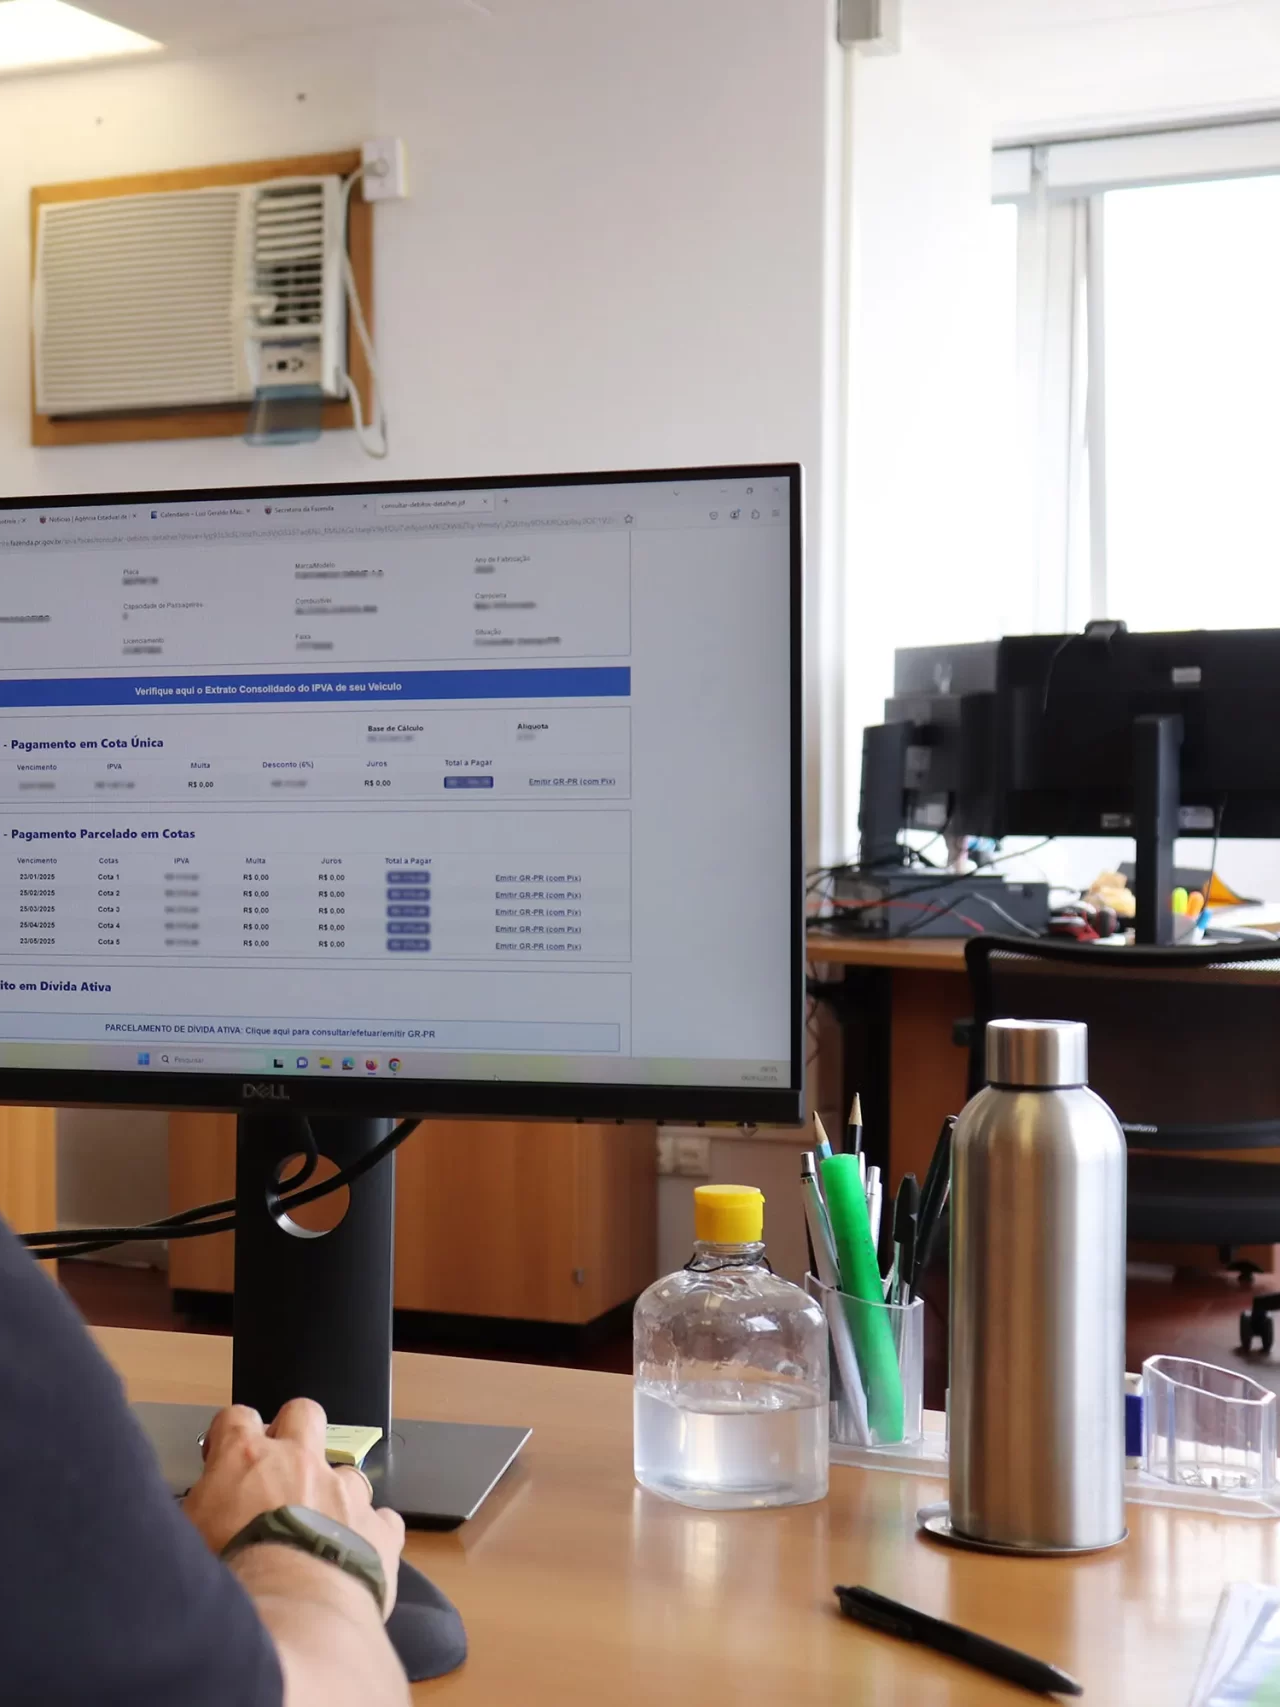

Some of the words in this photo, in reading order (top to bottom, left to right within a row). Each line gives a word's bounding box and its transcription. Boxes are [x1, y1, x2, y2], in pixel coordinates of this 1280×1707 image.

[134, 686, 173, 697] Verifique
[174, 686, 195, 696] aqui
[205, 685, 237, 694] Extrato
[239, 683, 296, 694] Consolidado
[298, 683, 310, 693] do
[311, 683, 333, 692] IPVA
[335, 682, 347, 692] de
[349, 683, 366, 692] seu
[386, 724, 396, 732] de
[397, 723, 424, 732] Cálculo
[11, 738, 76, 753] Pagamento
[79, 740, 98, 750] em
[101, 738, 128, 749] Cota
[131, 735, 164, 749] Única
[16, 763, 58, 771] Vencimento
[262, 761, 297, 769] Desconto
[365, 760, 388, 768] Juros
[444, 759, 462, 767] Total
[470, 759, 493, 768] Pagar
[187, 781, 197, 789] R$
[198, 781, 214, 789] 0,00
[364, 780, 374, 788] R$
[11, 829, 76, 842] Pagamento
[80, 828, 138, 840] Parcelado
[140, 831, 159, 840] em
[162, 828, 196, 840] Cotas
[16, 857, 58, 865] Vencimento
[98, 857, 119, 865] Cotas
[245, 857, 266, 865] Multa
[320, 857, 342, 865] Juros
[385, 857, 403, 865] Total
[410, 857, 432, 866] Pagar
[97, 873, 114, 881] Cota
[243, 874, 253, 882] R$
[254, 874, 270, 882] 0,00
[318, 874, 328, 882] R$
[329, 874, 346, 882] 0,00
[97, 890, 114, 898] Cota
[243, 890, 253, 898] R$
[254, 890, 270, 898] 0,00
[318, 891, 328, 899] R$
[329, 891, 346, 899] 0,00
[97, 906, 114, 914] Cota
[243, 907, 253, 915] R$
[254, 907, 270, 915] 0,00
[318, 907, 328, 915] R$
[329, 907, 346, 915] 0,00
[97, 922, 114, 930] Cota
[243, 923, 253, 931] R$
[254, 923, 270, 931] 0,00
[318, 924, 328, 932] R$
[329, 924, 346, 932] 0,00
[97, 938, 114, 946] Cota
[243, 939, 253, 947] R$
[254, 939, 270, 947] 0,00
[318, 941, 328, 949] R$
[329, 941, 346, 949] 0,00
[19, 983, 37, 991] em
[40, 979, 77, 992] Dívida
[81, 980, 112, 993] Ativa
[105, 1023, 172, 1033] PARCELAMENTO
[174, 1025, 185, 1033] DE
[187, 1024, 215, 1034] DÍVIDA
[217, 1025, 242, 1034] ATIVA:
[245, 1026, 271, 1036] Clique
[273, 1028, 290, 1037] aqui
[292, 1029, 310, 1037] para
[407, 1030, 436, 1039] GR-PR
[242, 1082, 290, 1100] DELL
